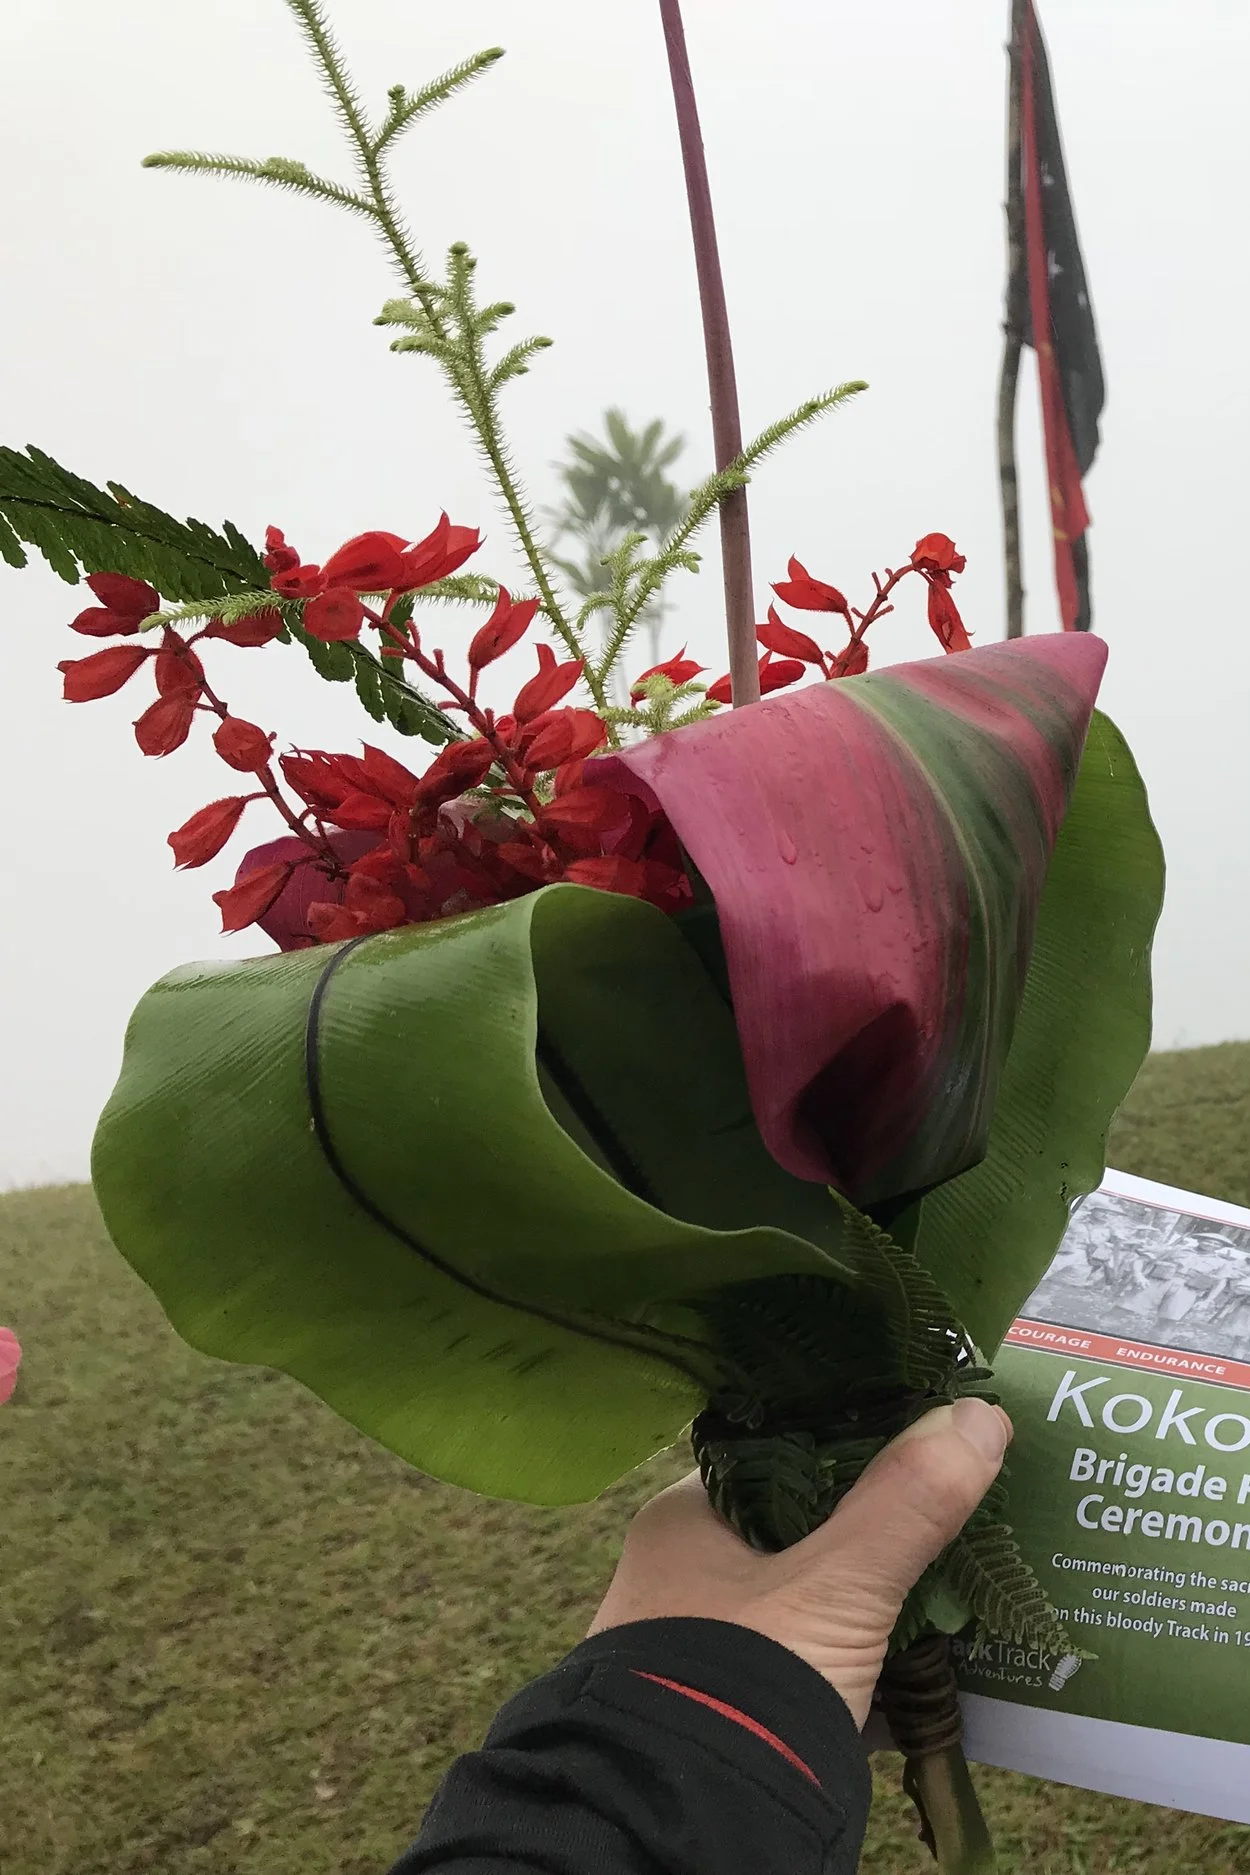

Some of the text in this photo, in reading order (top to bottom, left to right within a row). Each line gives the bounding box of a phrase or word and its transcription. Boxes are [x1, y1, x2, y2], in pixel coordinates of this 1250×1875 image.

[1008, 1326, 1092, 1349] COURAGE
[1116, 1347, 1227, 1375] ENDURANCE
[1069, 1447, 1225, 1502] Brigade
[1052, 1553, 1186, 1589] Commemorating
[1190, 1571, 1217, 1590] the
[1092, 1587, 1237, 1618] our soldiers made
[1073, 1606, 1102, 1626] this
[1106, 1611, 1164, 1638] bloody
[1167, 1620, 1209, 1641] Track
[1213, 1627, 1229, 1643] in
[958, 1660, 1043, 1687] Adventures
[994, 1640, 1051, 1671] Track
